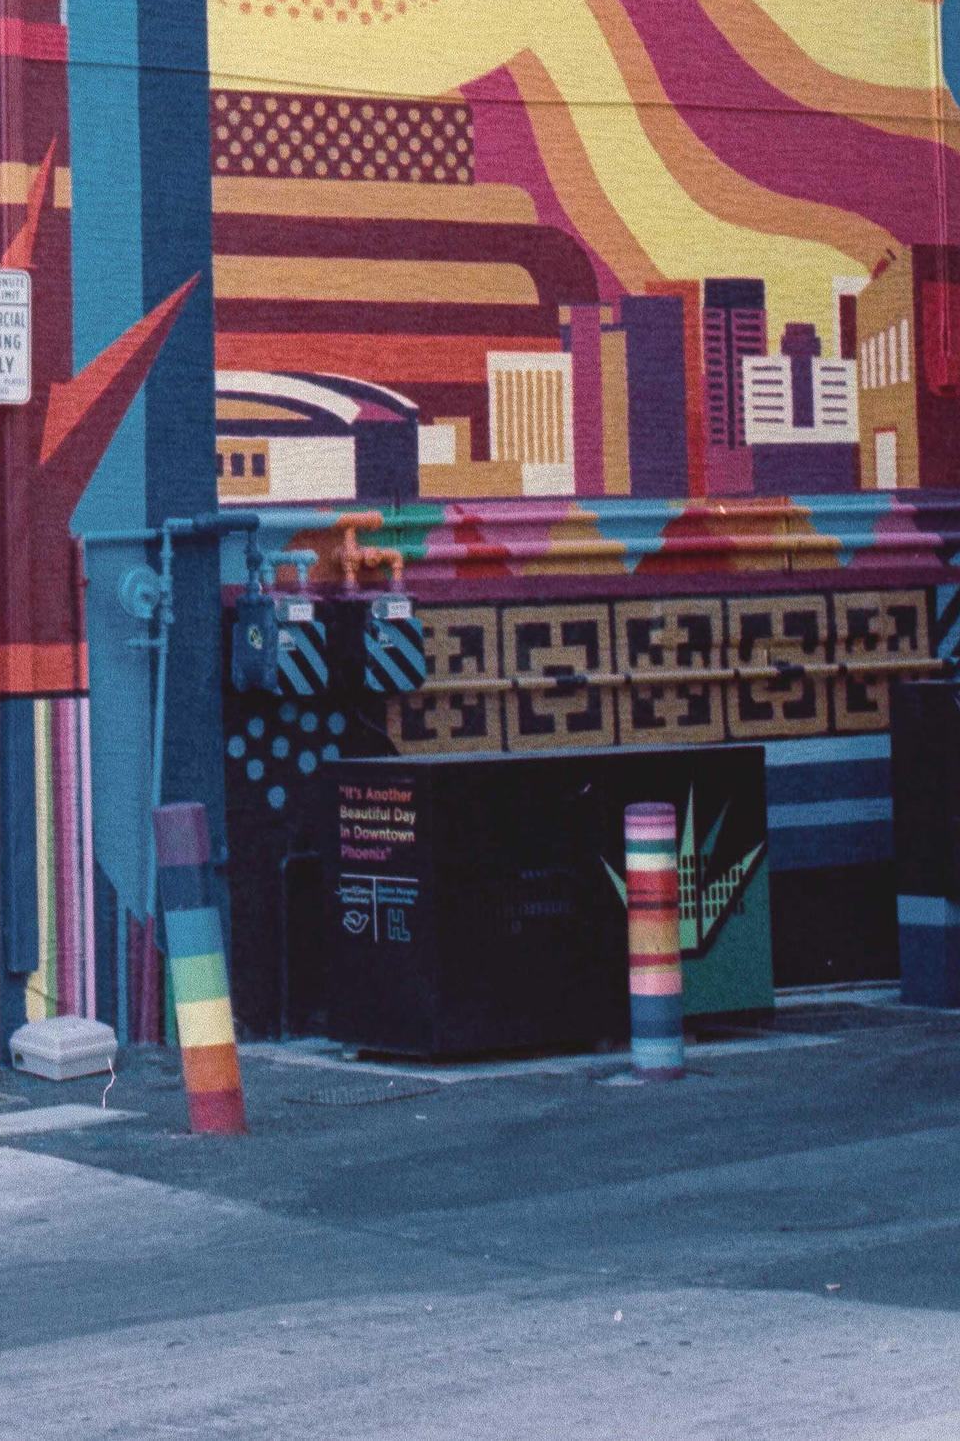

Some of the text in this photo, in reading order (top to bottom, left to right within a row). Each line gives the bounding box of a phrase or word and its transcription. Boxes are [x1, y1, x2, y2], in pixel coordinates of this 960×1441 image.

[365, 787, 413, 803] Another
[340, 804, 416, 825] Beautiful Day
[354, 825, 415, 842] Downtown
